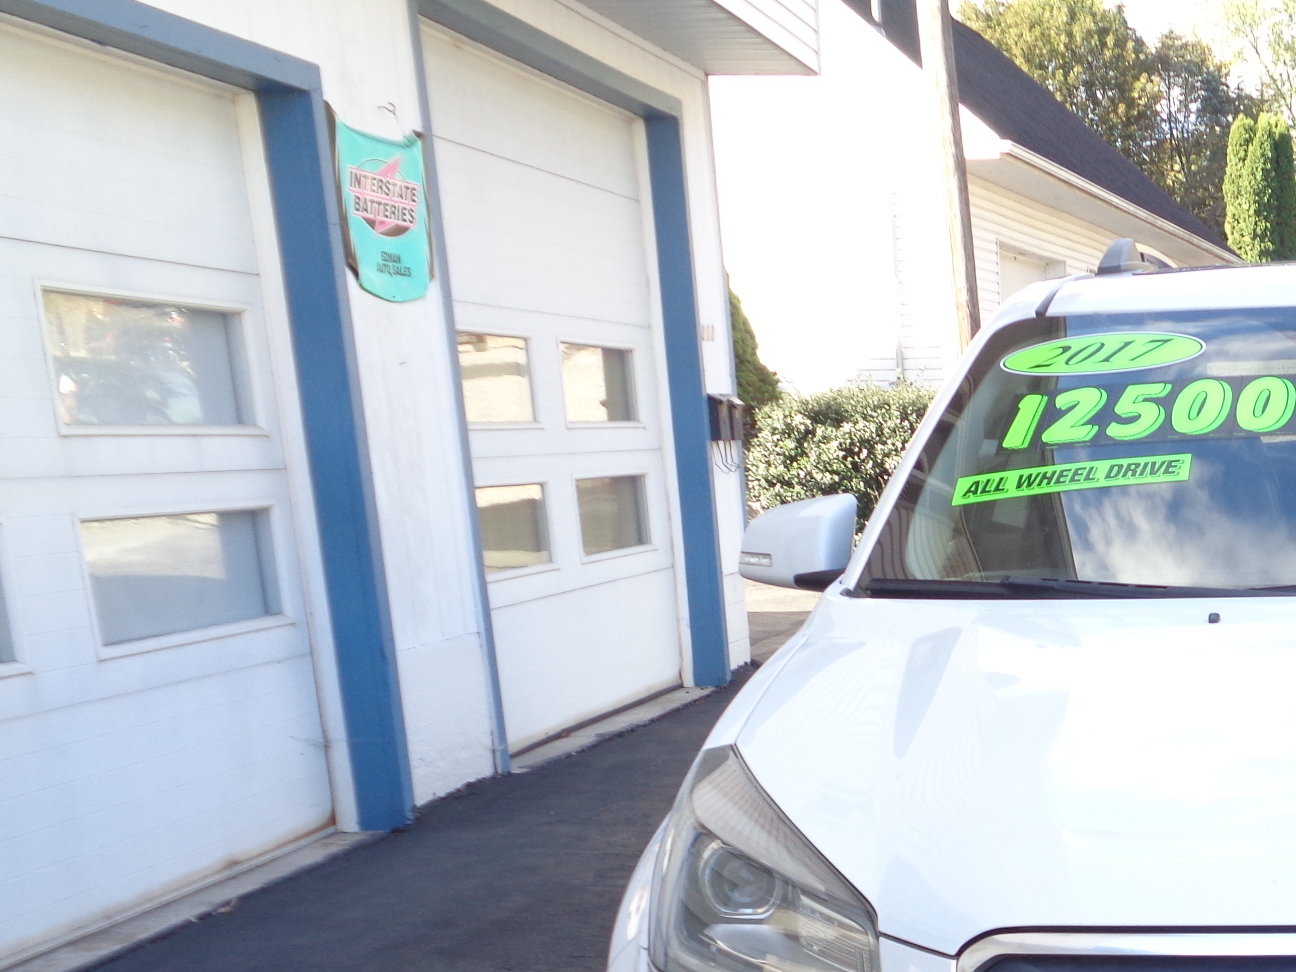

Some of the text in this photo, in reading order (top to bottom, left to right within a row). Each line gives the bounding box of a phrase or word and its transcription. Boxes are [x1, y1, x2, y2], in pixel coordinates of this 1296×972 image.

[349, 168, 418, 203] INTERSTATE
[353, 195, 415, 224] BATTERIES
[391, 264, 412, 277] SALES
[1028, 338, 1174, 370] 2017
[1002, 376, 1296, 450] 12500
[961, 459, 1185, 499] ALL WHEEL DRIVE
